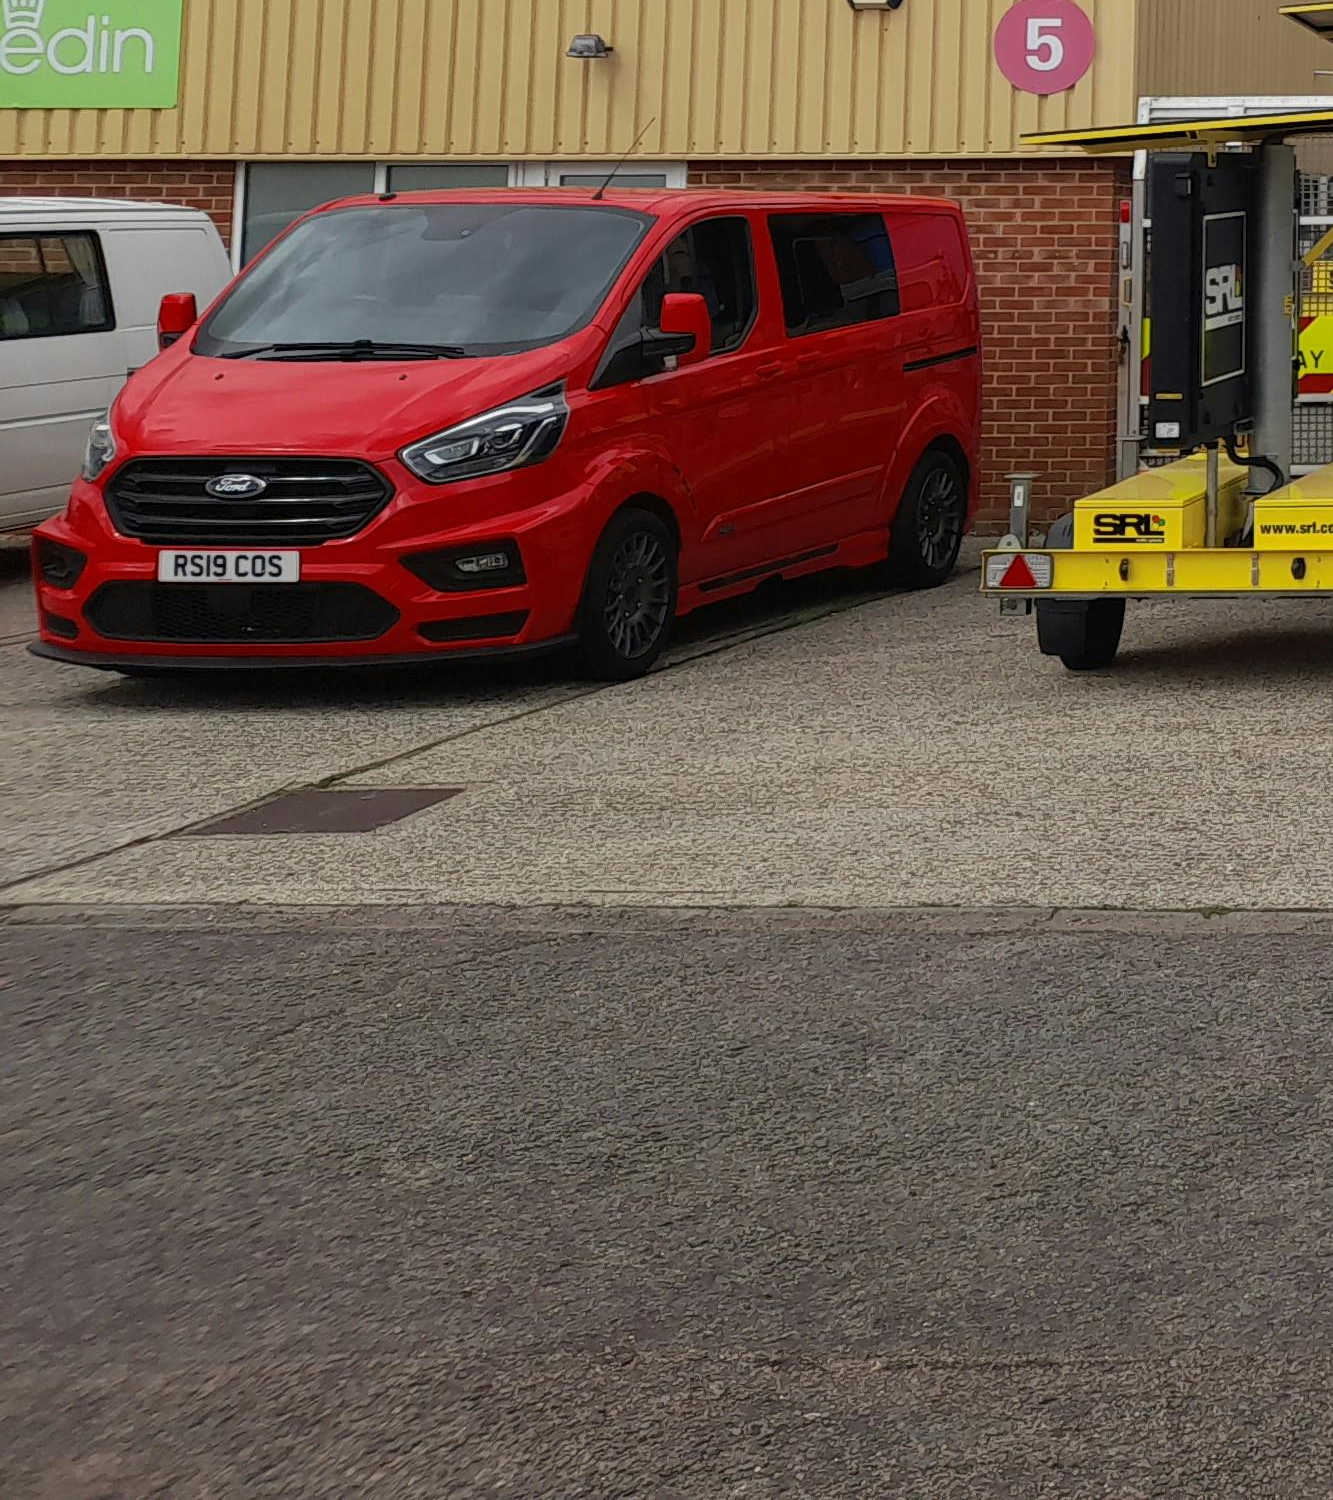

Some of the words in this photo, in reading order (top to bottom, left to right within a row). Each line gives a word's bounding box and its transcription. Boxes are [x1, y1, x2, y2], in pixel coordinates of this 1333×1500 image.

[1026, 18, 1064, 71] 5
[1205, 264, 1243, 316] SRL
[214, 476, 254, 492] Ford
[1093, 513, 1165, 536] SRL
[174, 554, 227, 577] RS19
[234, 554, 283, 577] COS
